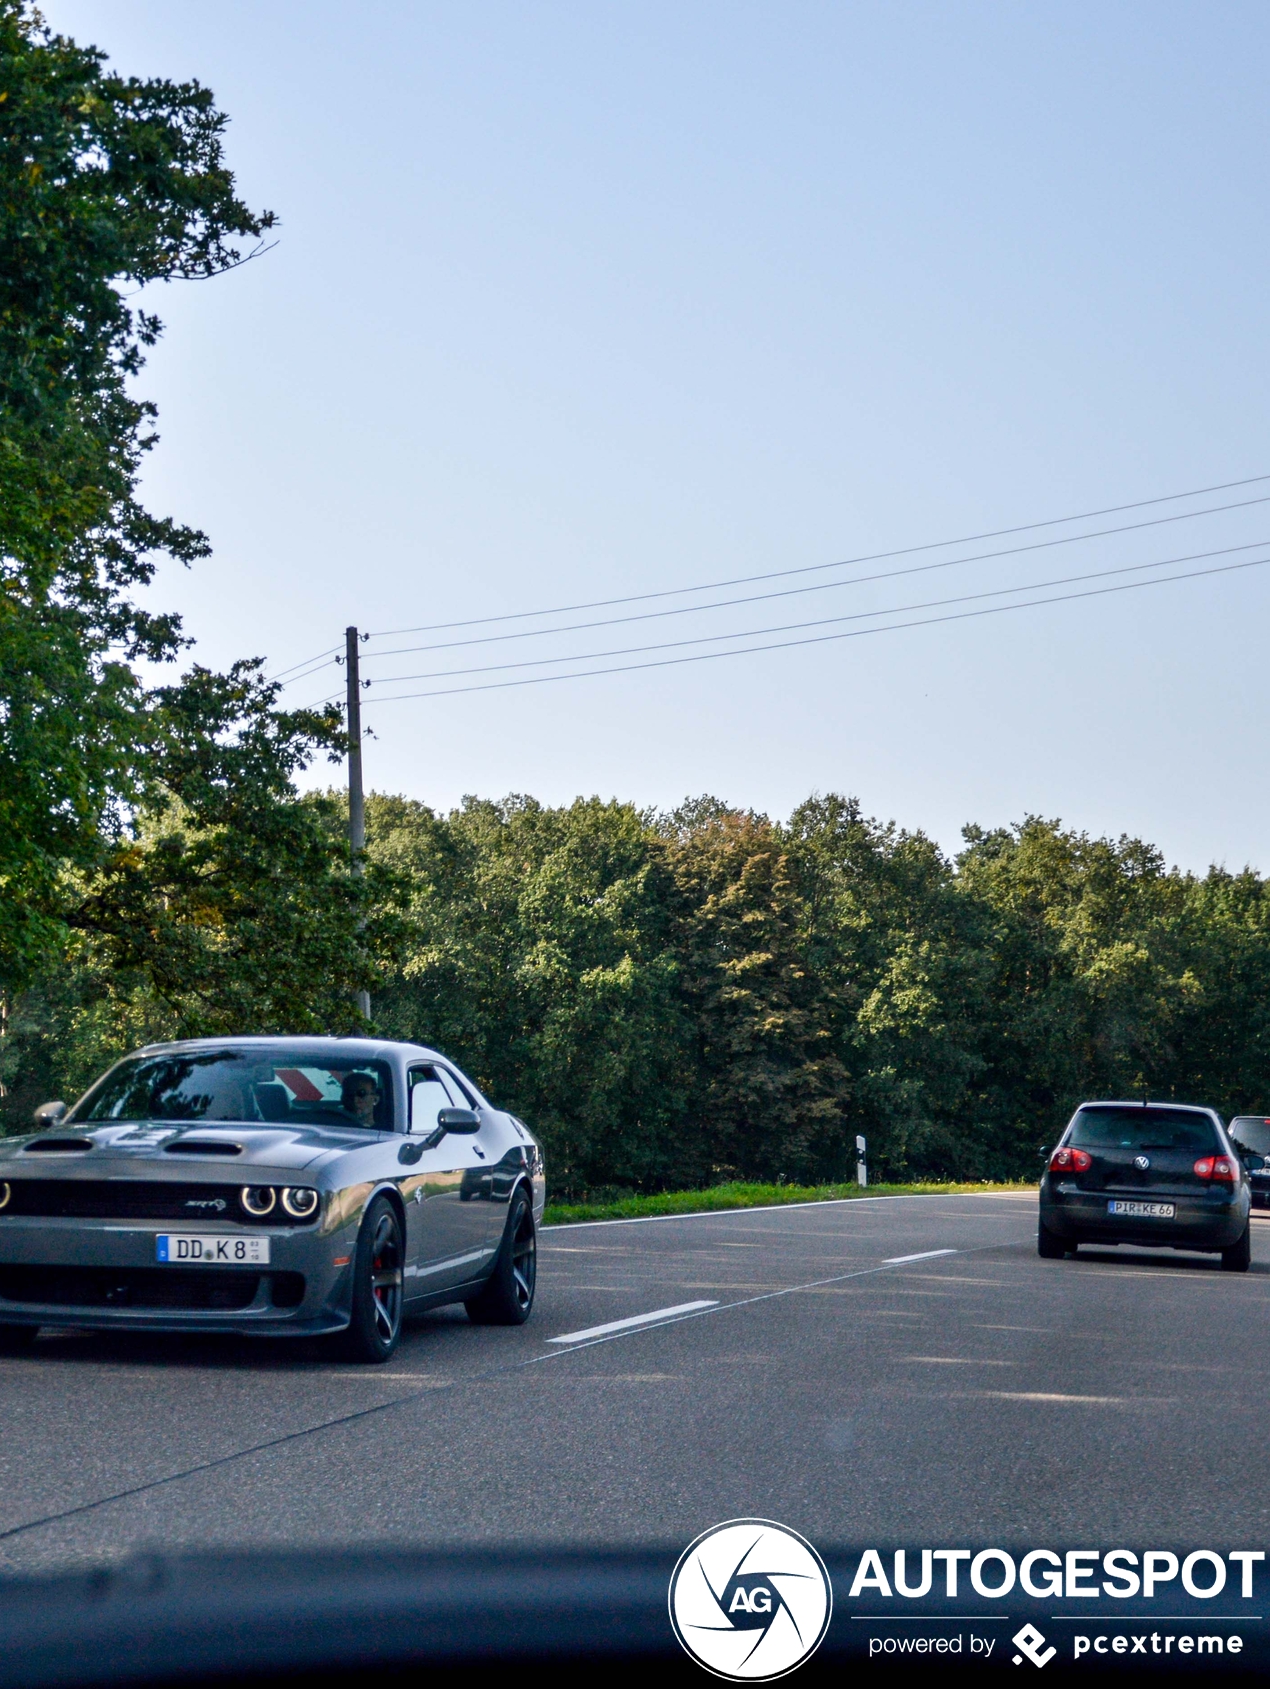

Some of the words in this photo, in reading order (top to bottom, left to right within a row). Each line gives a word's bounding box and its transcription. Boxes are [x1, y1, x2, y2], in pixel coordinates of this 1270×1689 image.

[1115, 1202, 1136, 1213] PIR
[1142, 1203, 1157, 1214] KE
[1158, 1205, 1172, 1215] 66
[176, 1239, 203, 1259] DD
[216, 1240, 229, 1259] K
[234, 1240, 246, 1260] 8
